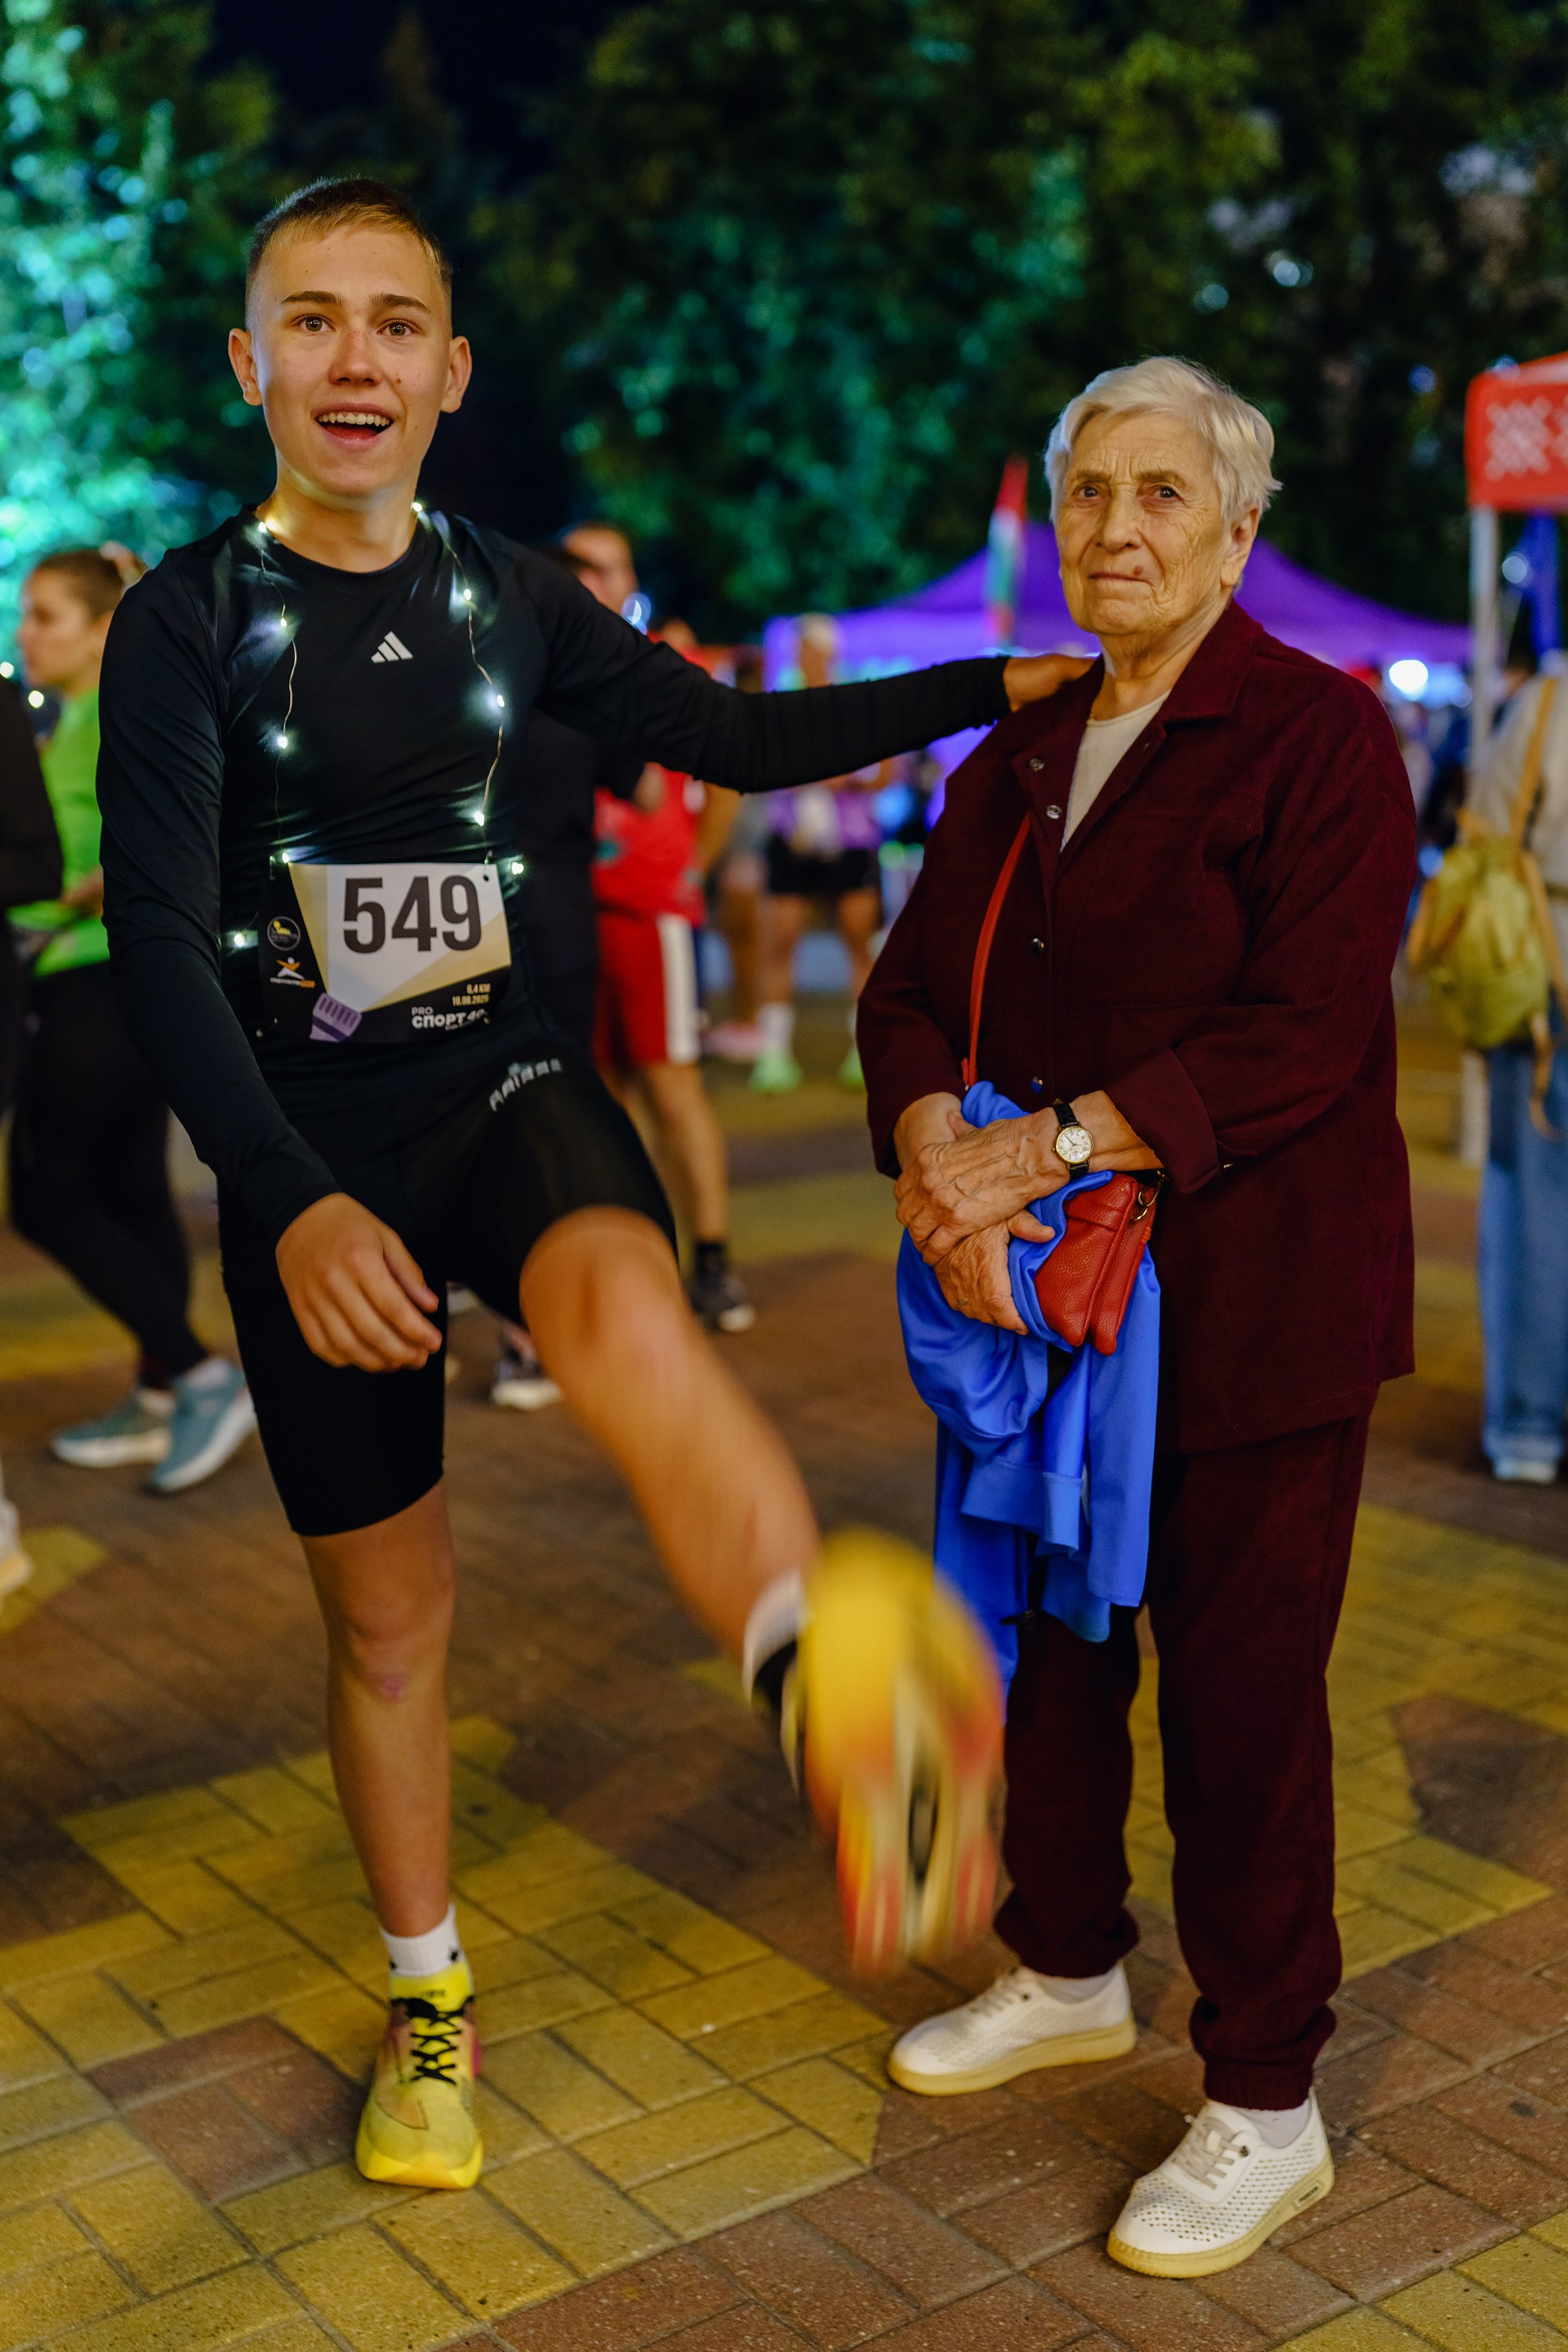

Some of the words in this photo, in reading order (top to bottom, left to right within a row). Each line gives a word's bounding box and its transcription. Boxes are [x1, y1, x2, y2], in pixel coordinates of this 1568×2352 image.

[343, 875, 481, 953] 549
[412, 1007, 433, 1016] PRO
[412, 1012, 466, 1029] СПОРТ
